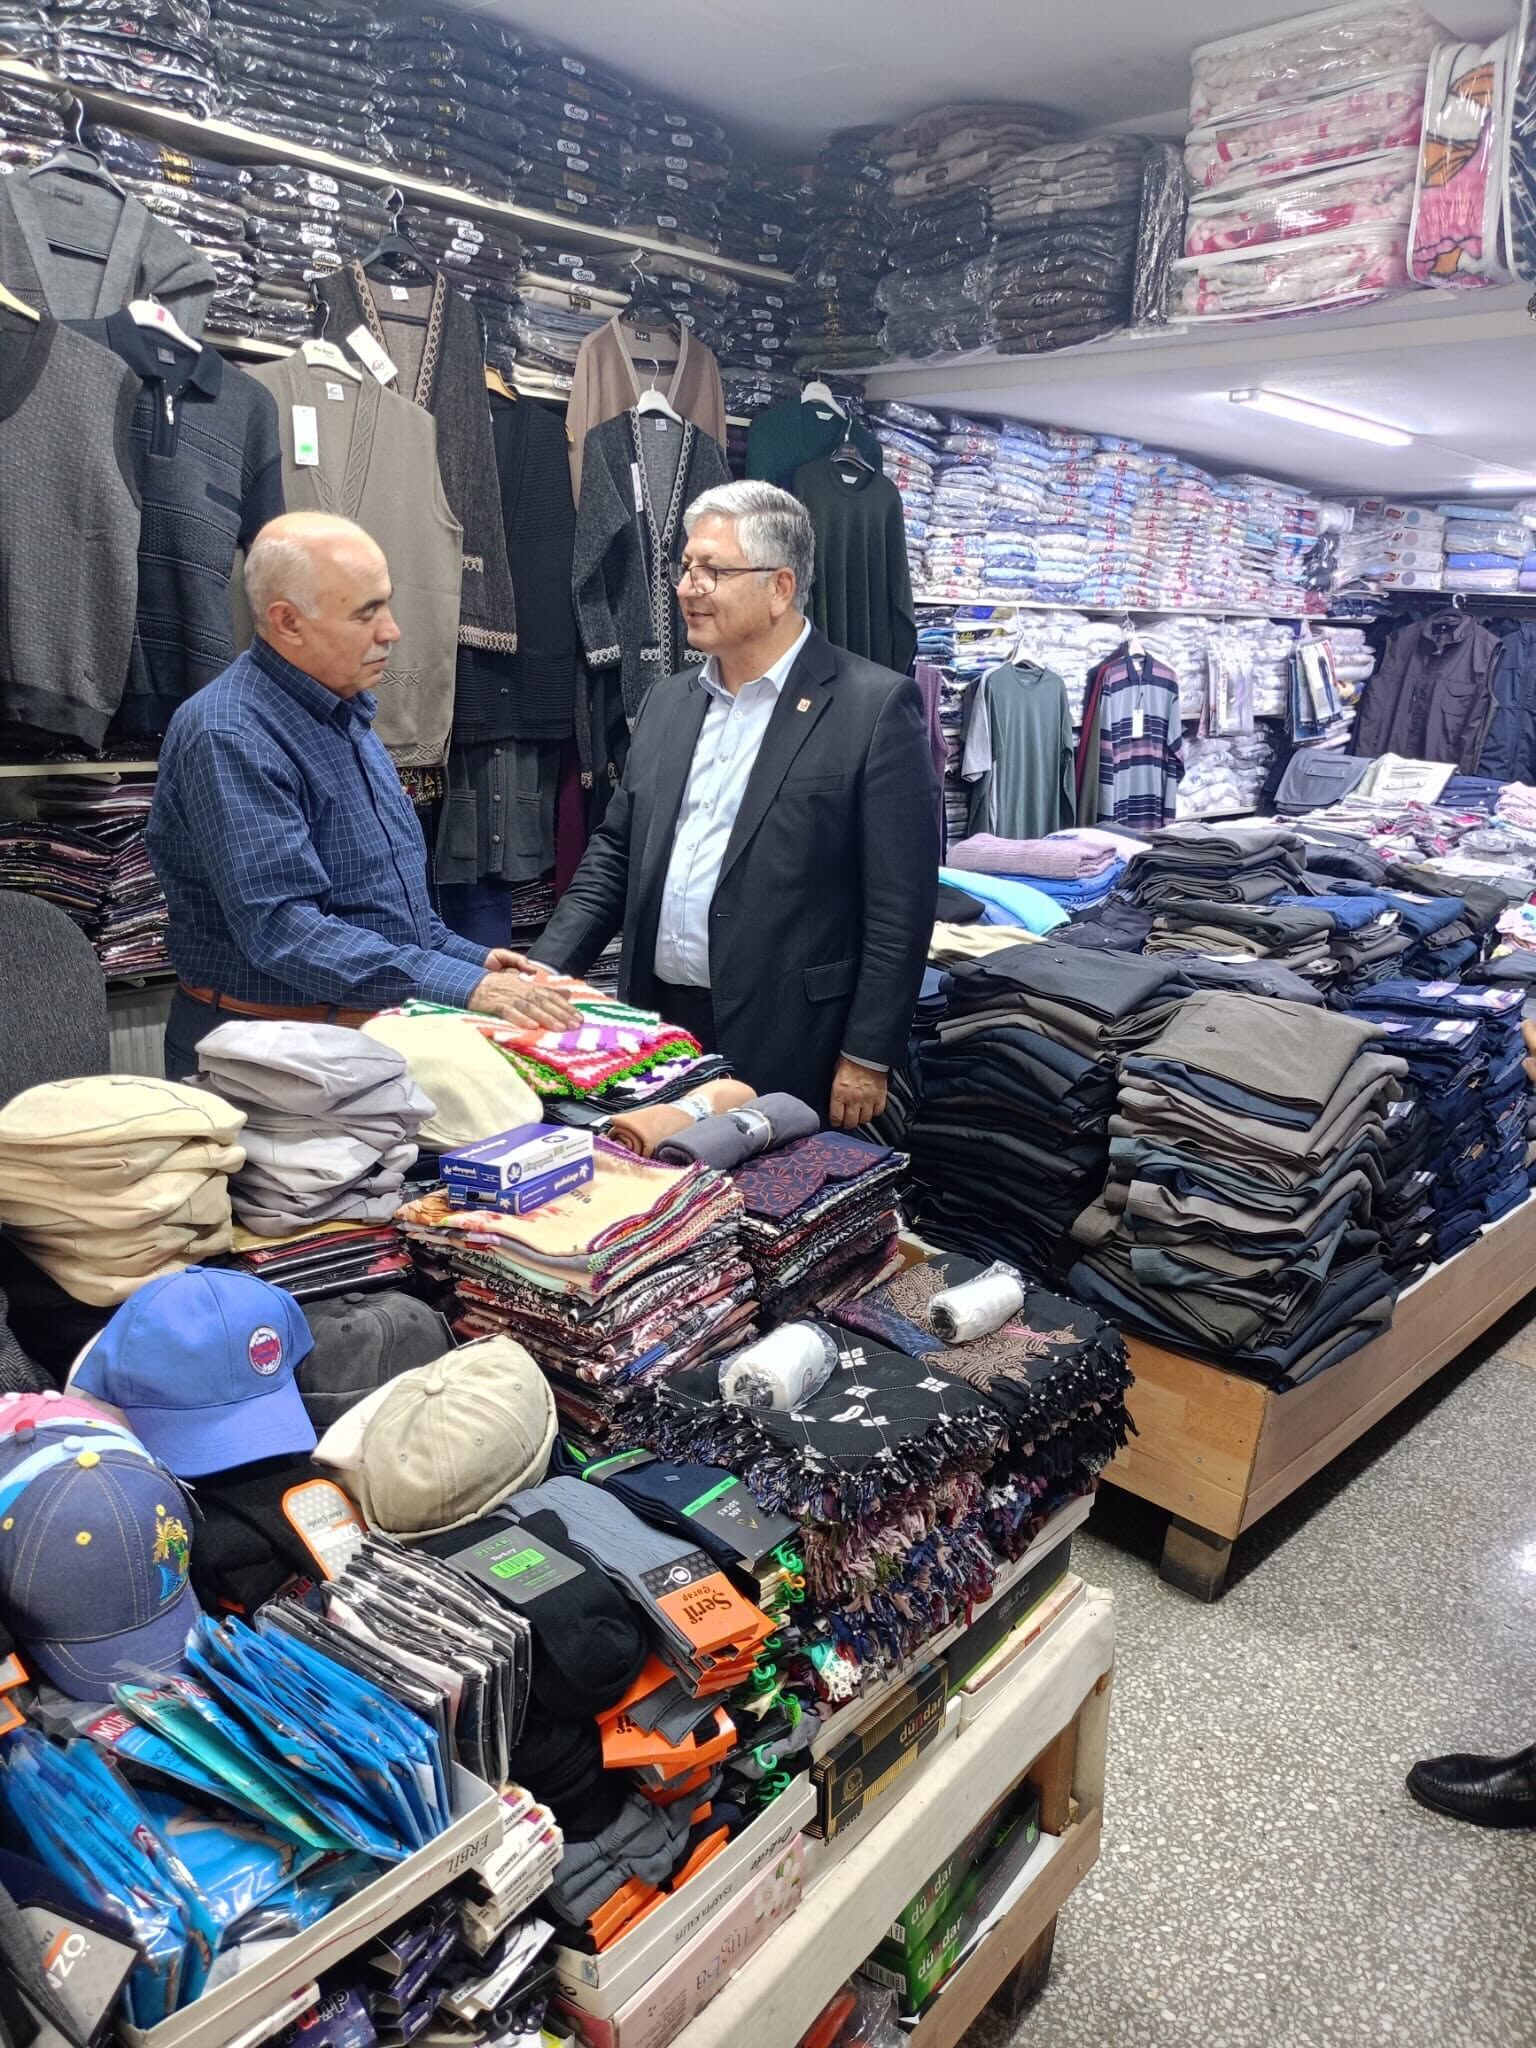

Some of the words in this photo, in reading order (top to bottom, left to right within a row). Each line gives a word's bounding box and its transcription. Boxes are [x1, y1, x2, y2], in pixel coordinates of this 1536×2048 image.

[899, 1695, 943, 1745] dündar
[910, 1861, 953, 1926] dündar
[917, 1911, 965, 1979] dündar
